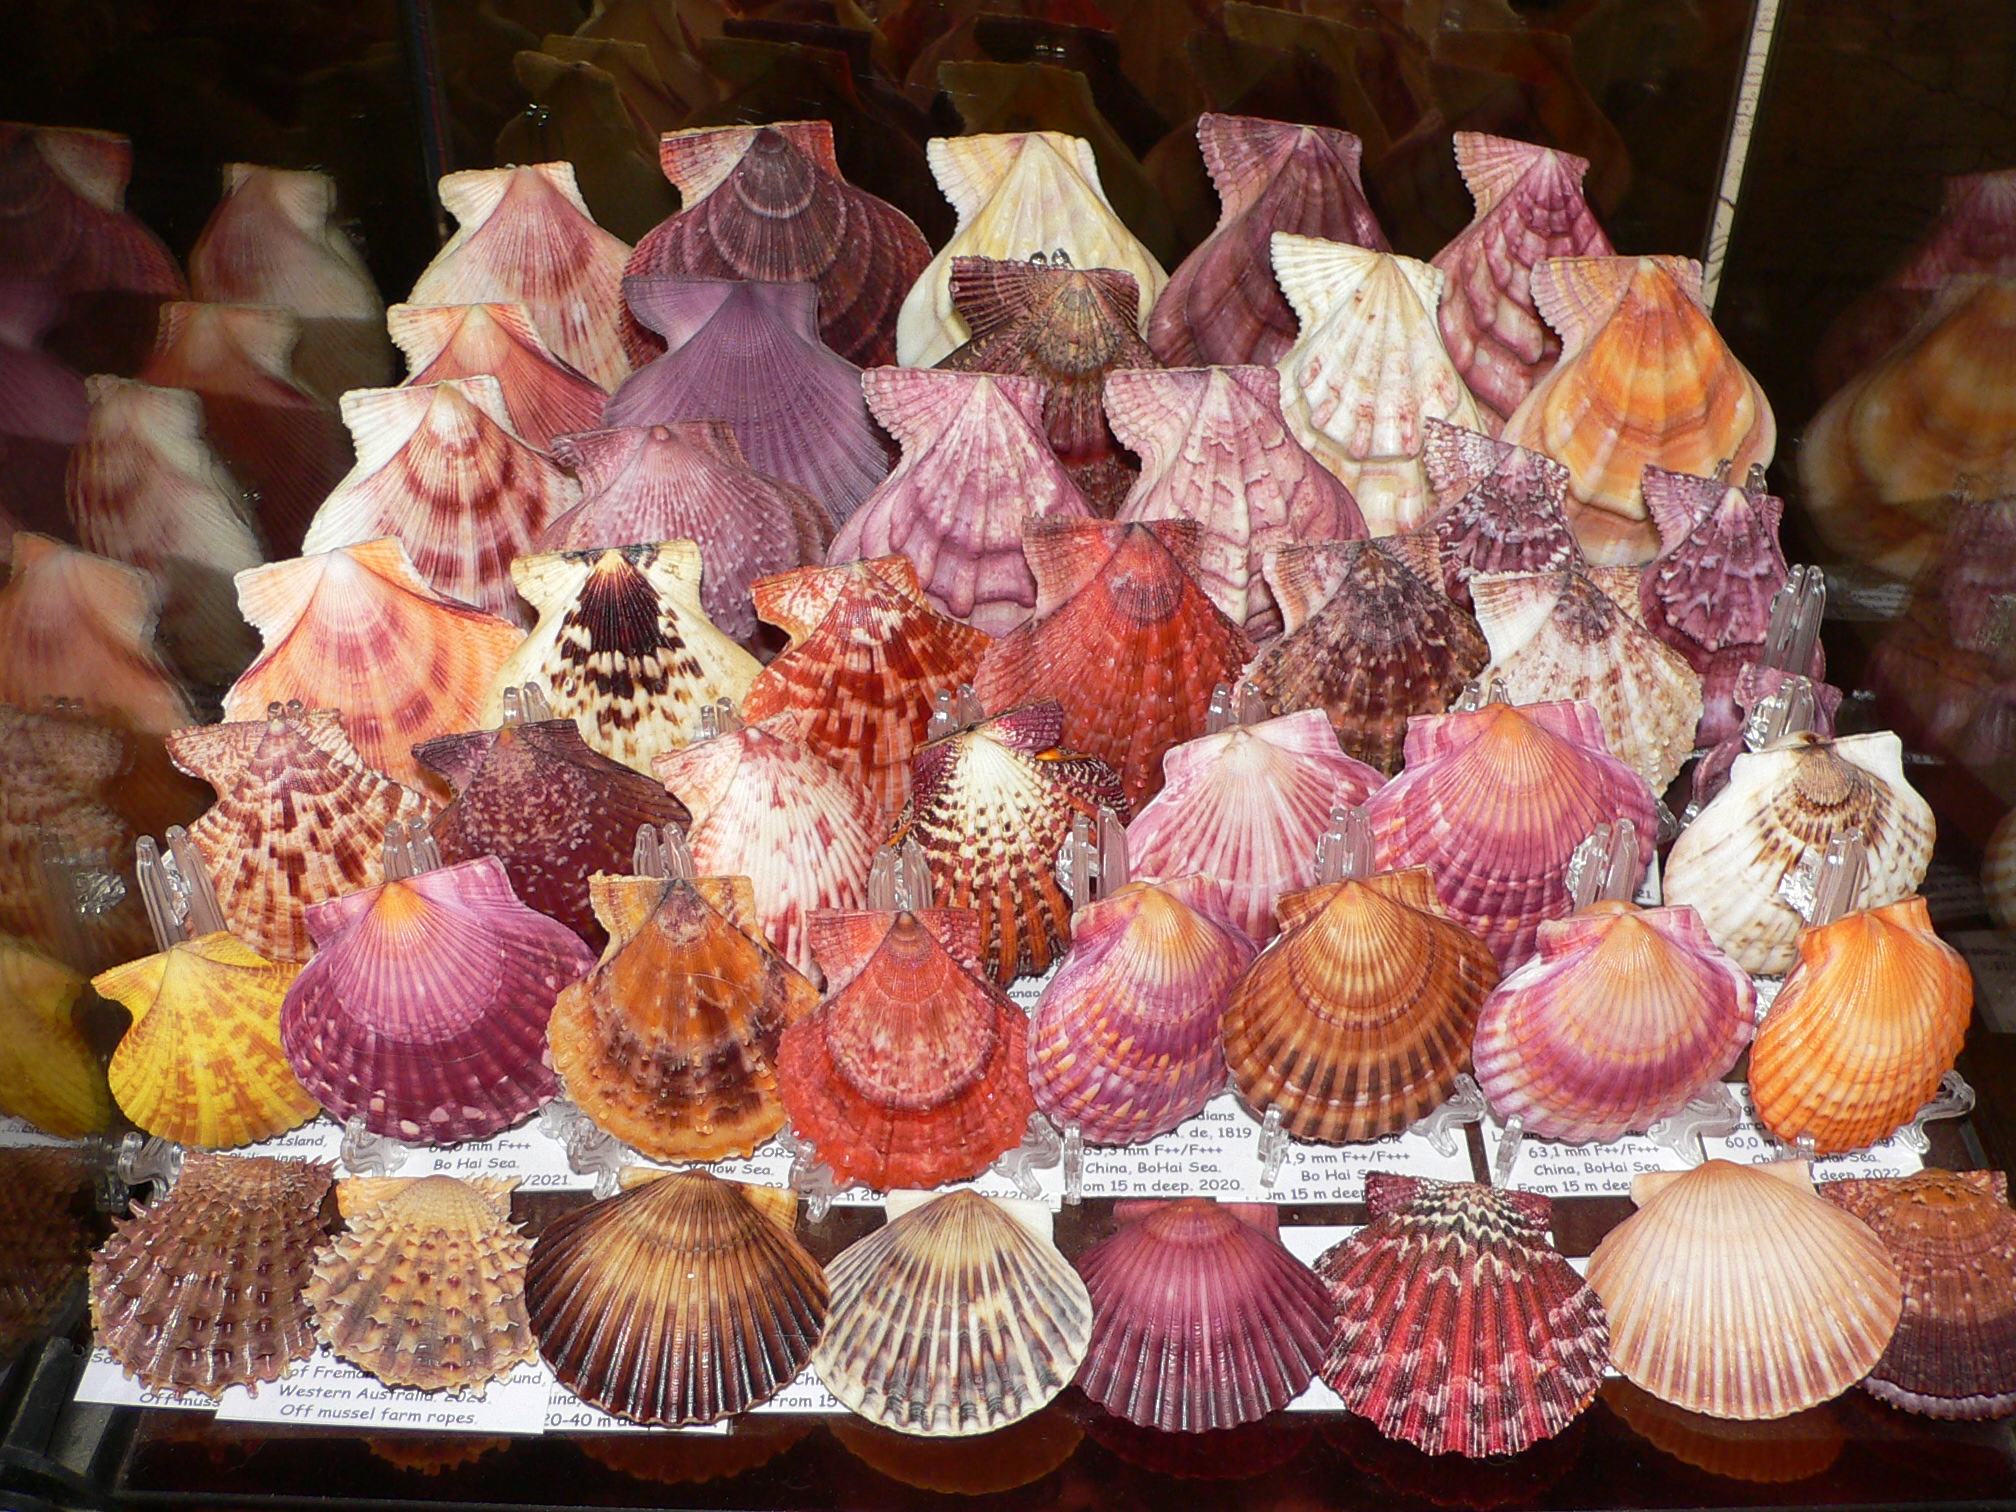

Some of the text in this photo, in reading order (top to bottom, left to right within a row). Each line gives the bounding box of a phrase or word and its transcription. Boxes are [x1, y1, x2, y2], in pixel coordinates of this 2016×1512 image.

[1189, 1127, 1213, 1140] de,
[1218, 1127, 1252, 1139] 1819
[467, 1142, 493, 1152] mm
[498, 1140, 532, 1151] F+++
[1725, 1136, 1758, 1150] 60,0
[1124, 1147, 1149, 1156] mm
[1154, 1144, 1223, 1156] F++/F+++
[1528, 1143, 1660, 1160] 63,1 mm F++/F+++
[433, 1158, 520, 1170] Bo Hai Sea.
[1284, 1150, 1410, 1166] 1,9 mm F++/F+++
[741, 1164, 775, 1175] Sea.
[1085, 1162, 1222, 1175] China, BoHai Sea.
[1301, 1170, 1320, 1181] Bo
[1325, 1168, 1351, 1181] Hai
[1534, 1163, 1580, 1176] China,
[1584, 1161, 1629, 1174] BoHai
[522, 1174, 573, 1186] /2021.
[1082, 1178, 1245, 1194] om 15 m deep. 2020.
[1291, 1187, 1308, 1199] 15
[1313, 1190, 1327, 1199] m
[1517, 1182, 1559, 1194] From
[1563, 1180, 1581, 1192] 15
[1585, 1181, 1598, 1191] m
[512, 1372, 547, 1387] und,
[279, 1384, 351, 1399] Western
[139, 1392, 176, 1405] Off
[768, 1393, 838, 1408] From 15
[280, 1404, 478, 1427] Off mussel farm ropes.
[597, 1416, 612, 1427] m
